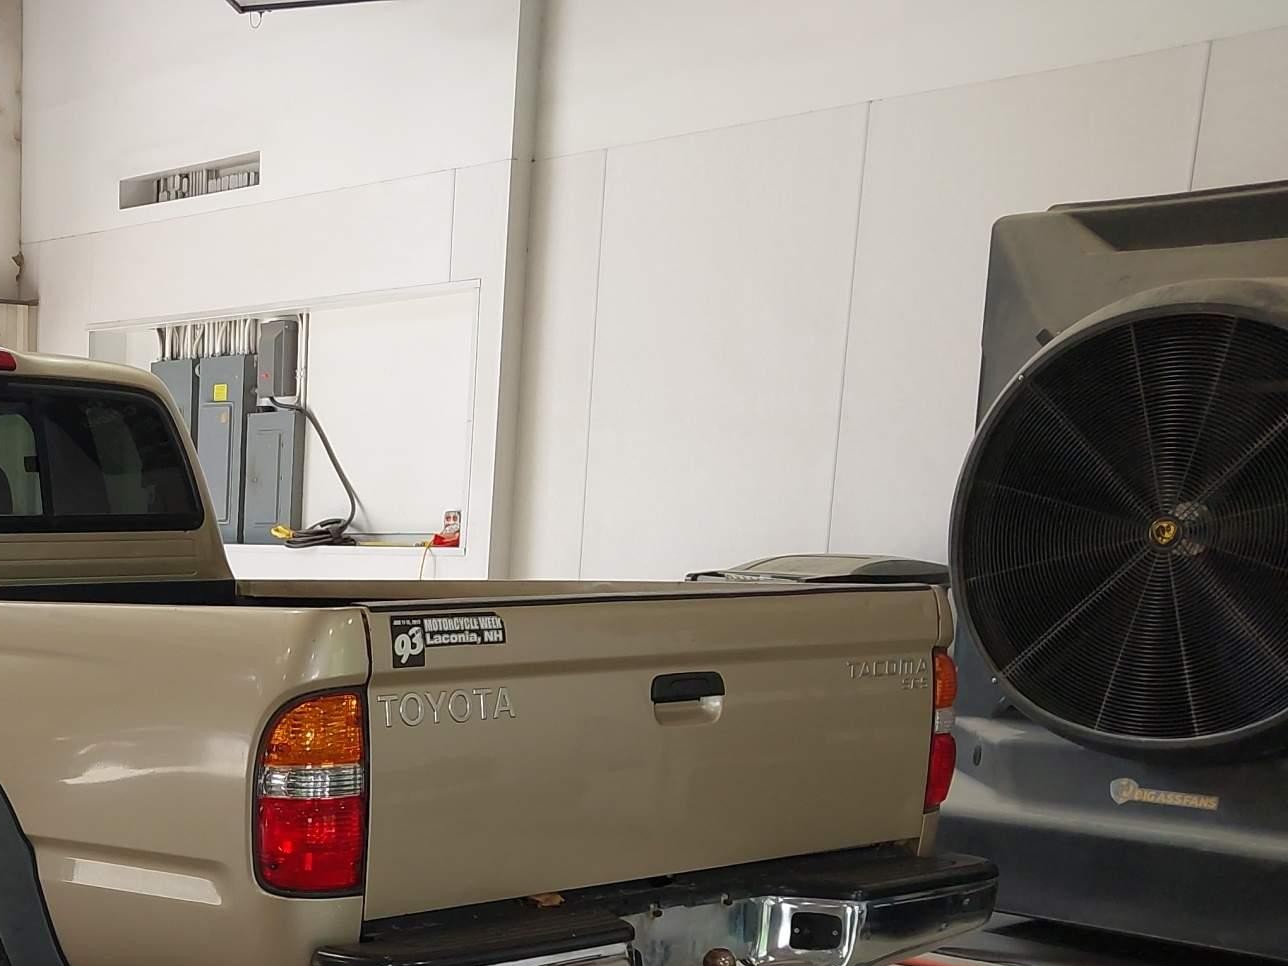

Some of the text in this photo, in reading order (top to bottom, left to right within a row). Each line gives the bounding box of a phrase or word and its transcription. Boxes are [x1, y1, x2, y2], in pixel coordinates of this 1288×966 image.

[423, 617, 479, 632] MOTORCYCLE
[478, 615, 503, 630] WEEK
[425, 630, 503, 645] Laconia, NH
[845, 658, 928, 679] TACOMA
[377, 687, 516, 728] TOYOTA
